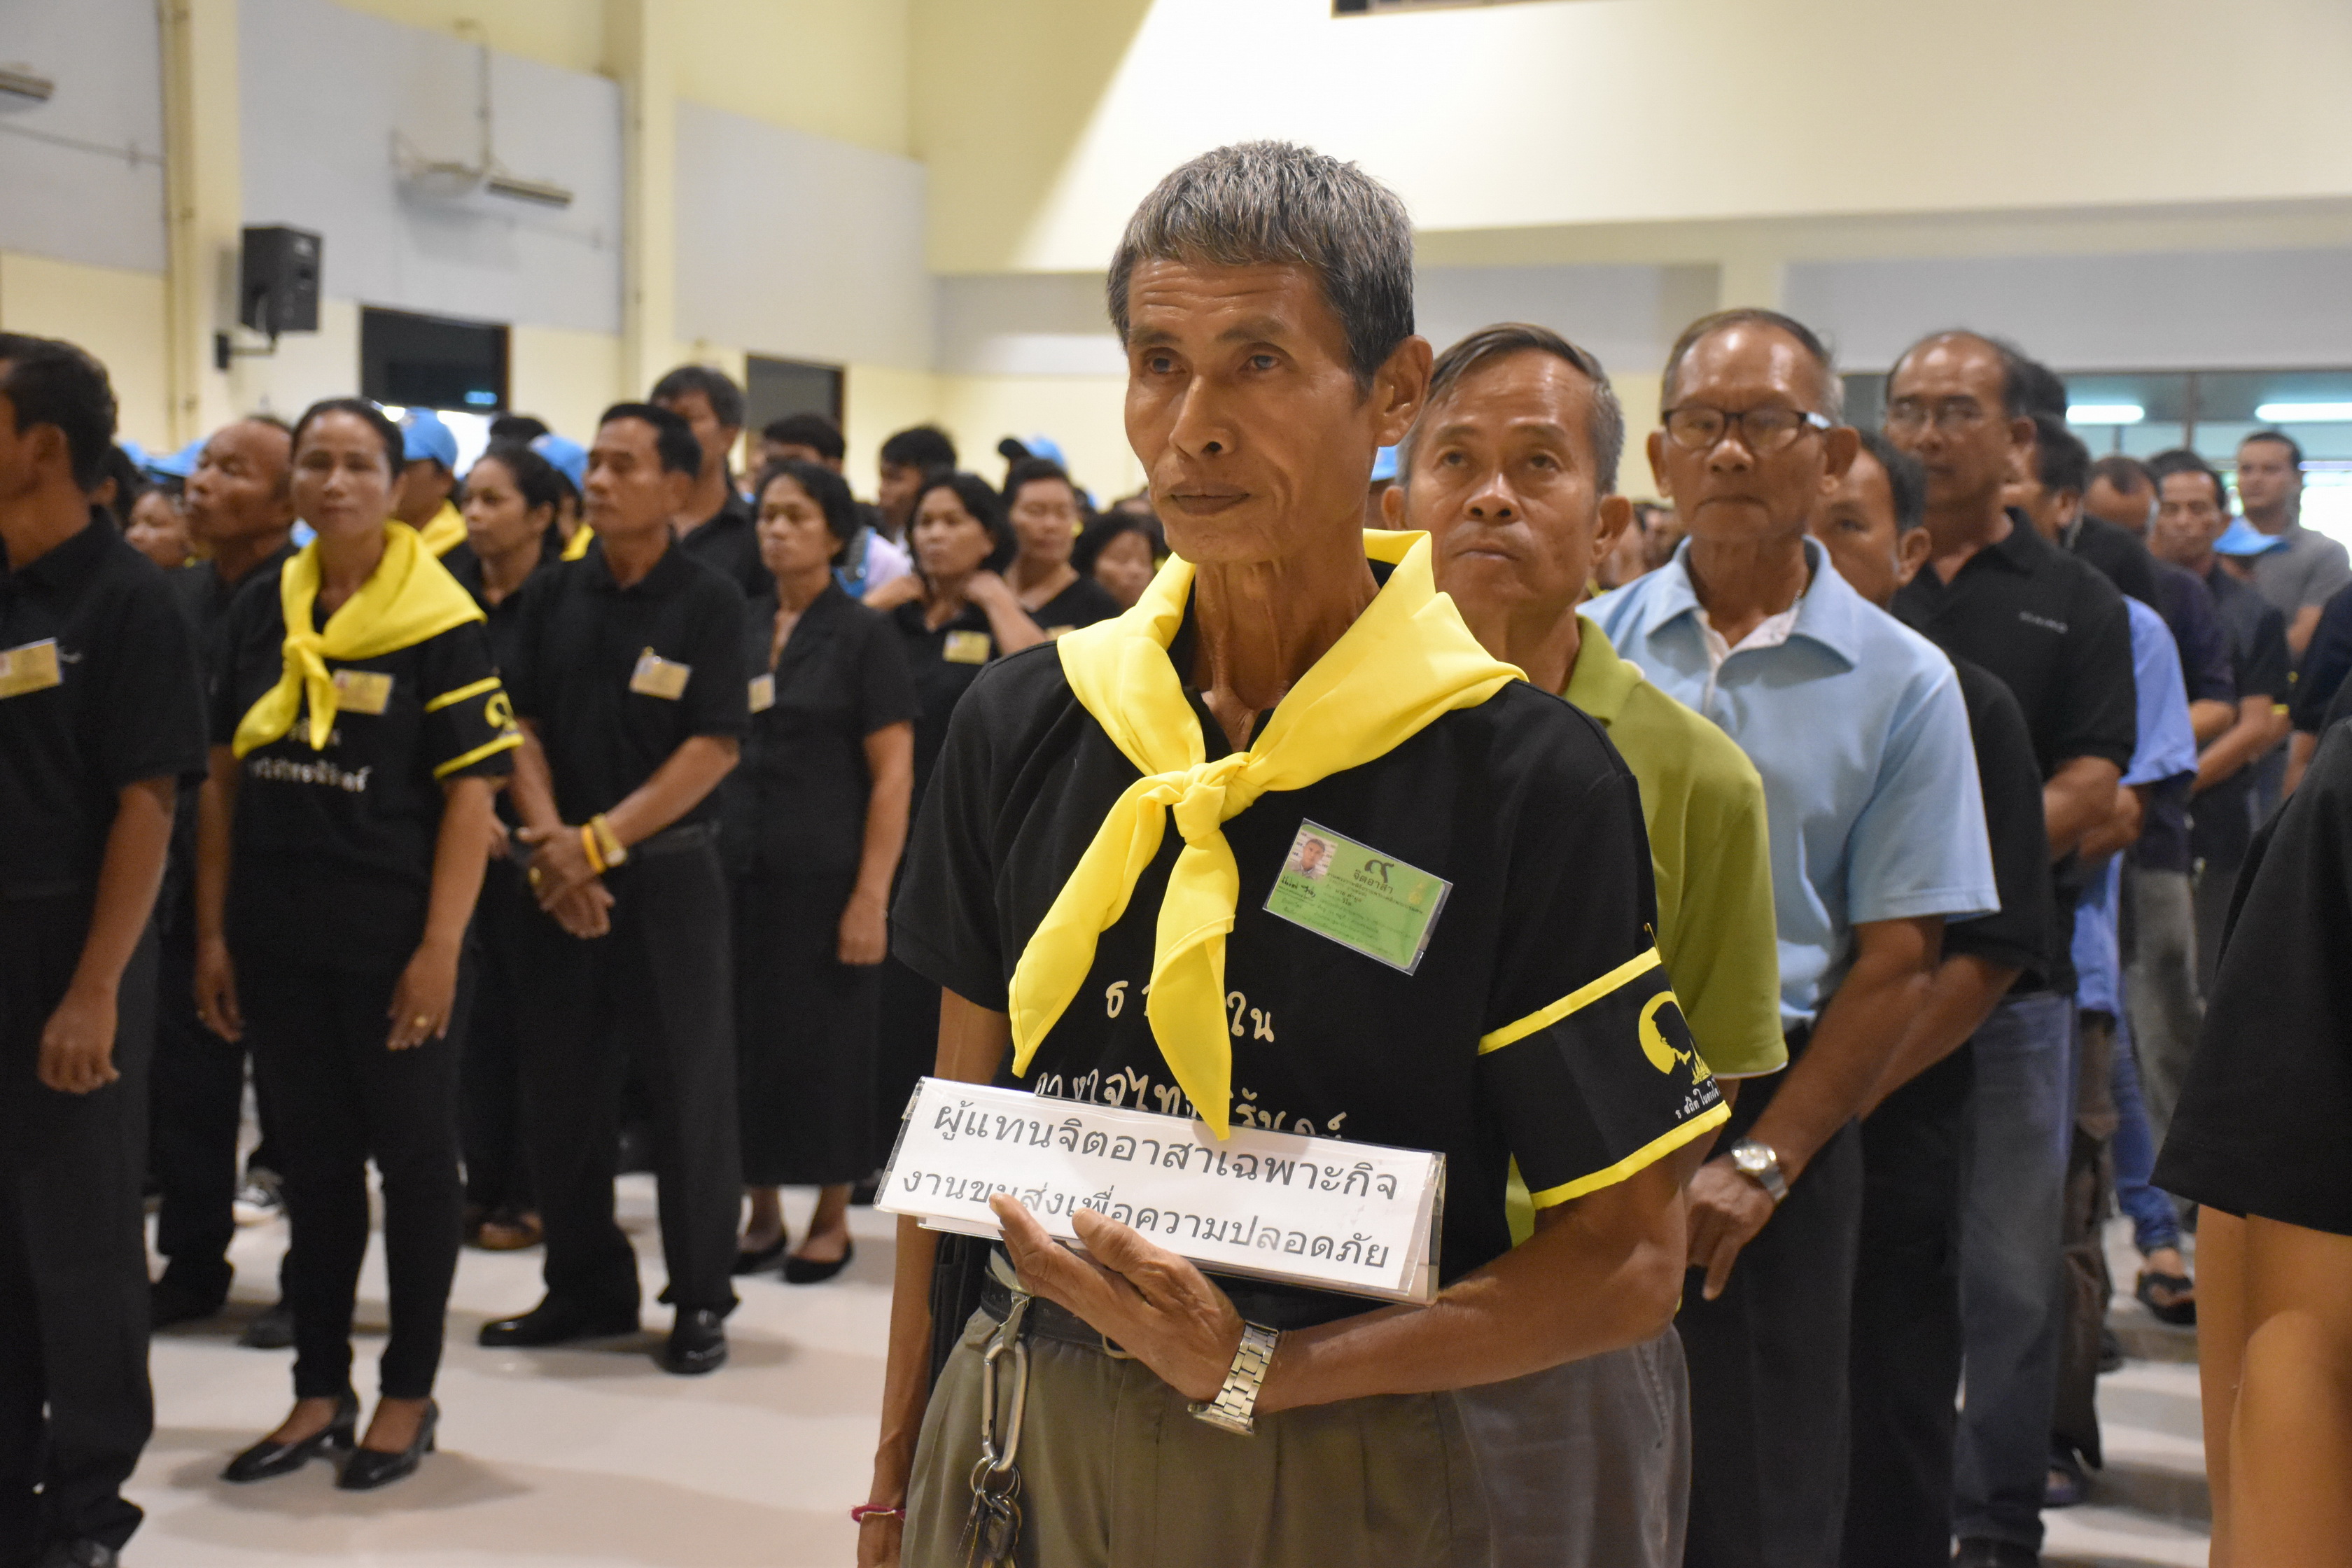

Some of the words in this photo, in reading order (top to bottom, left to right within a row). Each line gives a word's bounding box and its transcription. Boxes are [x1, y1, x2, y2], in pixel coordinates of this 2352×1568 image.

[1105, 980, 1128, 1018] ธ
[933, 1100, 1399, 1200] ผู้แทนจิตอาสาเฉพาะกิจ
